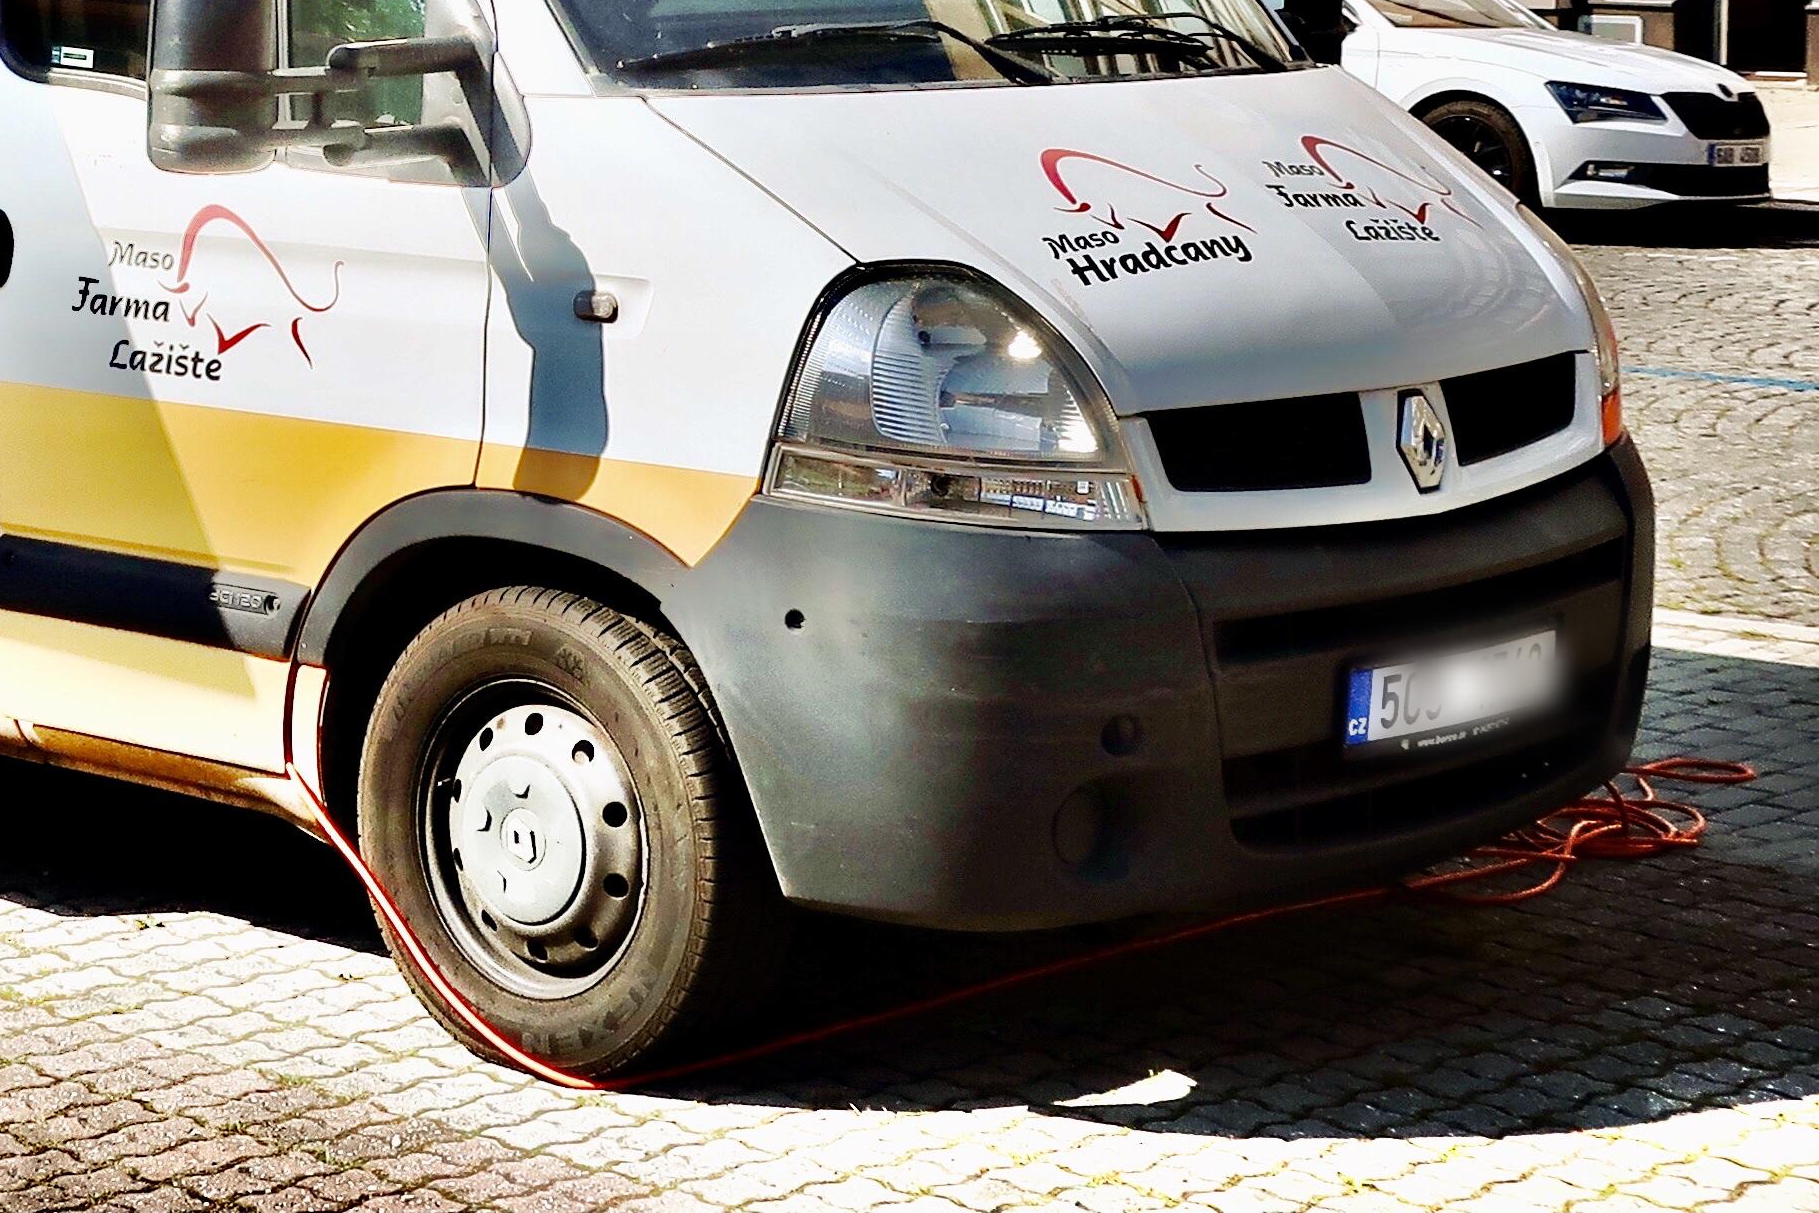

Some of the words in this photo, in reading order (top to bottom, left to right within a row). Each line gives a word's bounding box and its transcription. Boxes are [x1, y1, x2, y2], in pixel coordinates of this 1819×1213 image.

[1261, 161, 1325, 178] Maso
[1265, 184, 1366, 208] Farma
[108, 241, 175, 270] Maso
[1042, 230, 1120, 259] Maso
[71, 276, 170, 322] Farma
[1348, 717, 1368, 736] CZ
